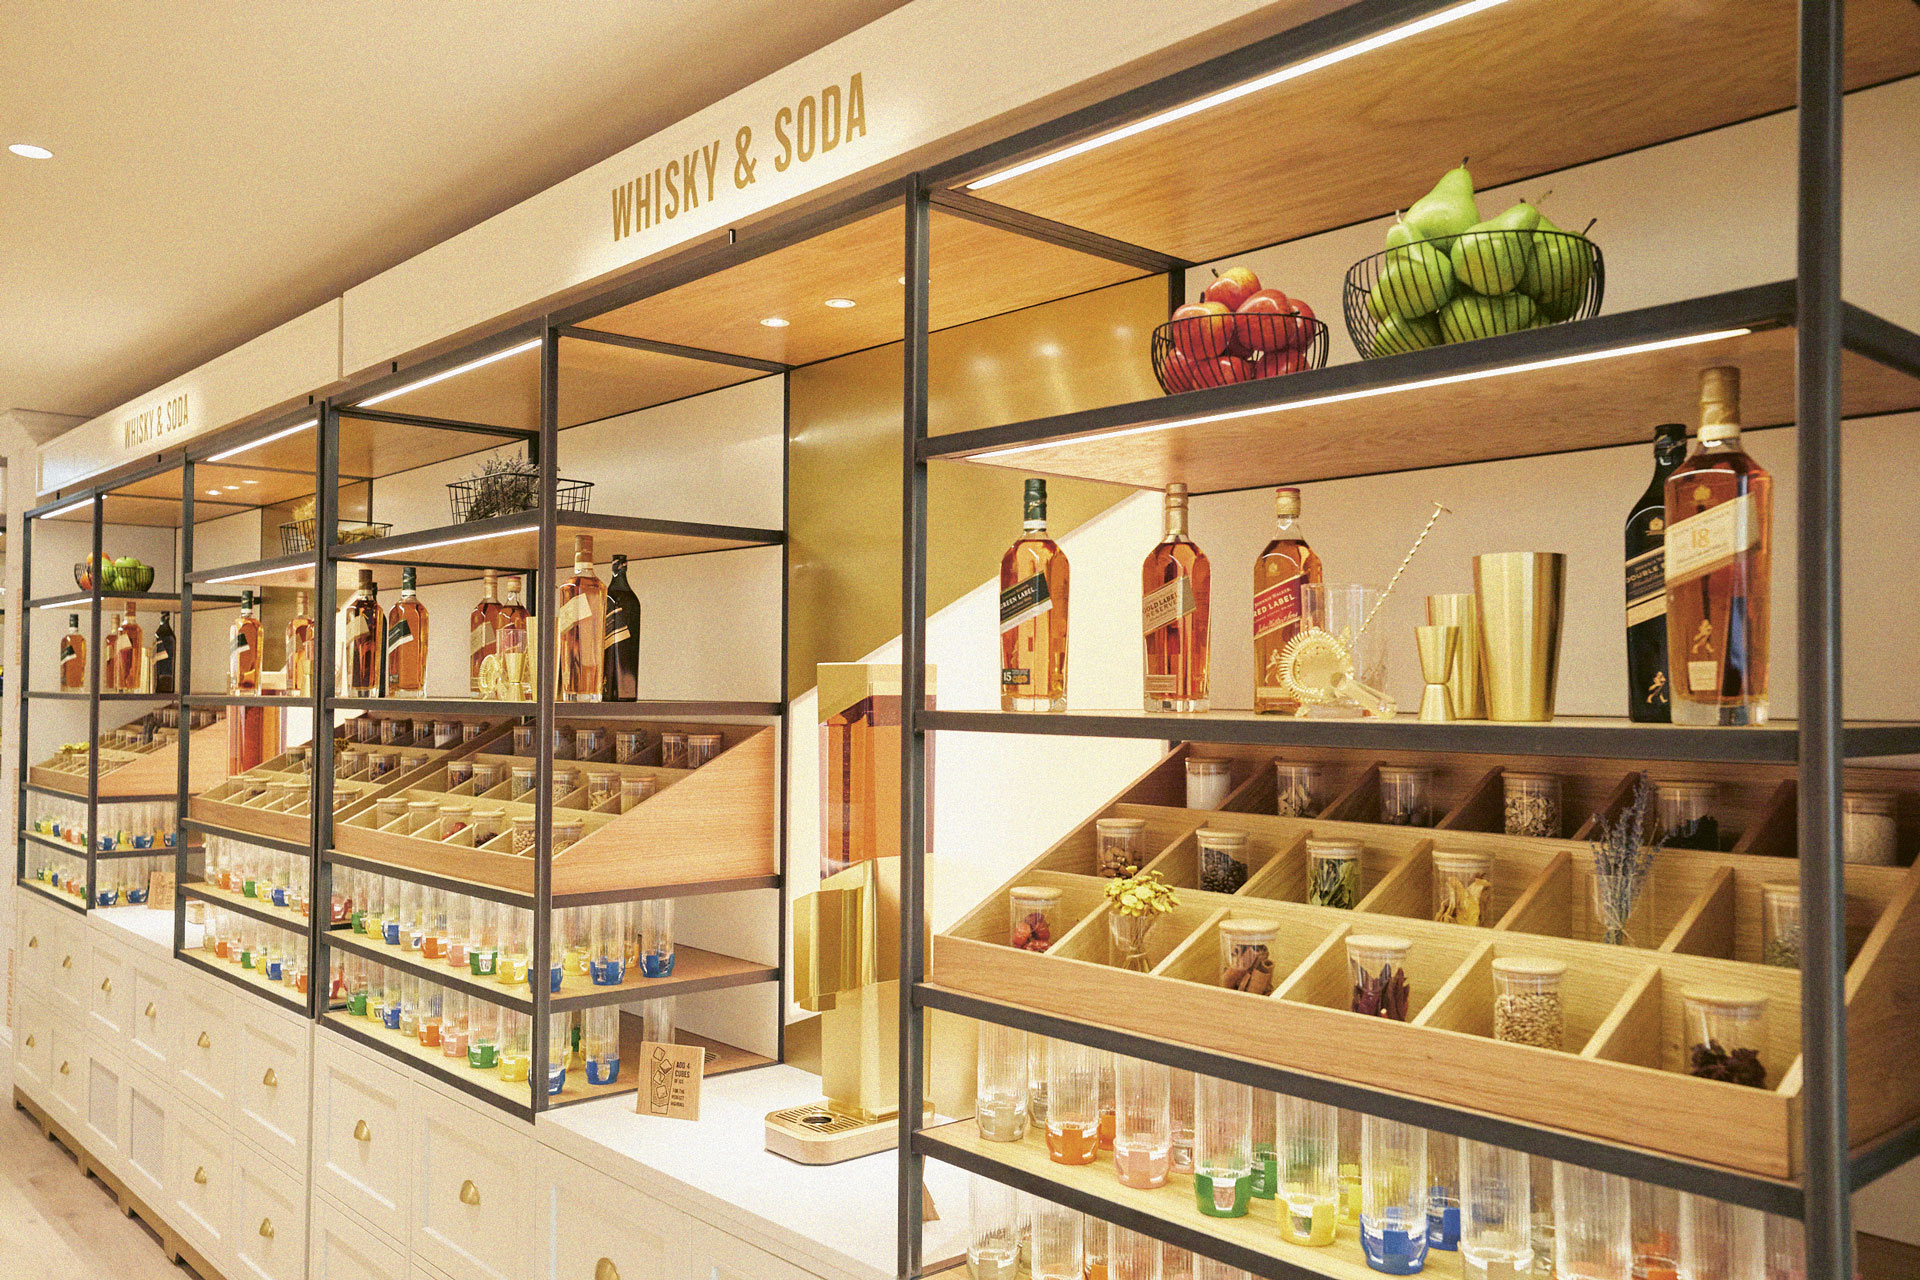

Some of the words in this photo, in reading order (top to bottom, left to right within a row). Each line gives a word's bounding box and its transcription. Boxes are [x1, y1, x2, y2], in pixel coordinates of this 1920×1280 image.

[612, 140, 720, 241] WHISKY
[733, 125, 757, 190] &
[774, 72, 867, 173] SODA
[125, 409, 154, 449] WHISKY
[157, 405, 163, 437] &
[167, 393, 189, 432] SODA
[1691, 527, 1710, 549] 18
[1017, 586, 1036, 601] LABEL
[1268, 593, 1296, 610] LABEL
[1003, 671, 1012, 682] 15
